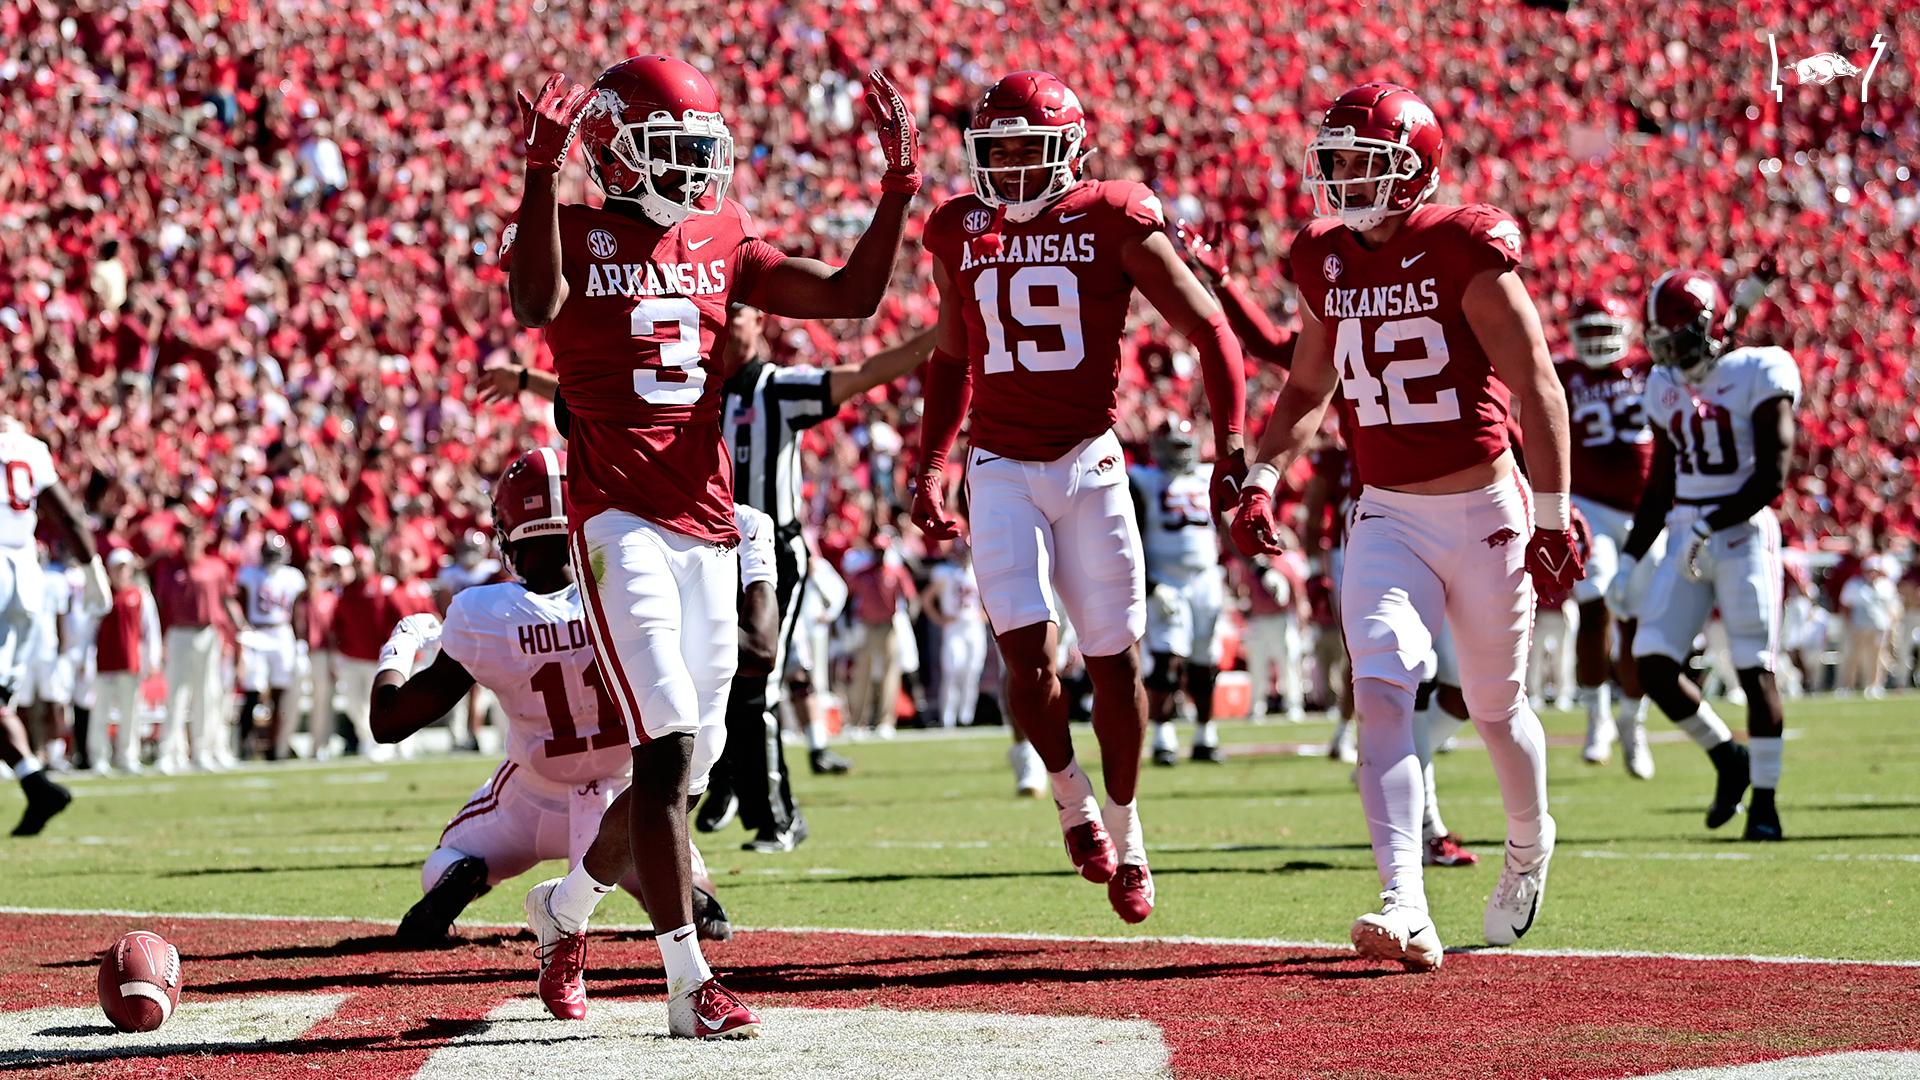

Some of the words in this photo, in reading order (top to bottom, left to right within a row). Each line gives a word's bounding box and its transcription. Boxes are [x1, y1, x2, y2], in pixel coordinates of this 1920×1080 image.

[997, 118, 1018, 126] HOGS
[965, 207, 989, 231] SEC
[588, 230, 616, 257] SEC
[960, 233, 1095, 271] AKANSAS
[585, 259, 726, 297] ARKANSAS
[973, 265, 1085, 375] 19
[630, 297, 706, 405] 3
[1333, 316, 1461, 427] 42
[1572, 394, 1650, 448] 33
[736, 445, 750, 464] U
[1670, 405, 1739, 476] 10
[517, 618, 593, 655] HOLD
[529, 658, 631, 759] 11
[577, 779, 600, 796] A
